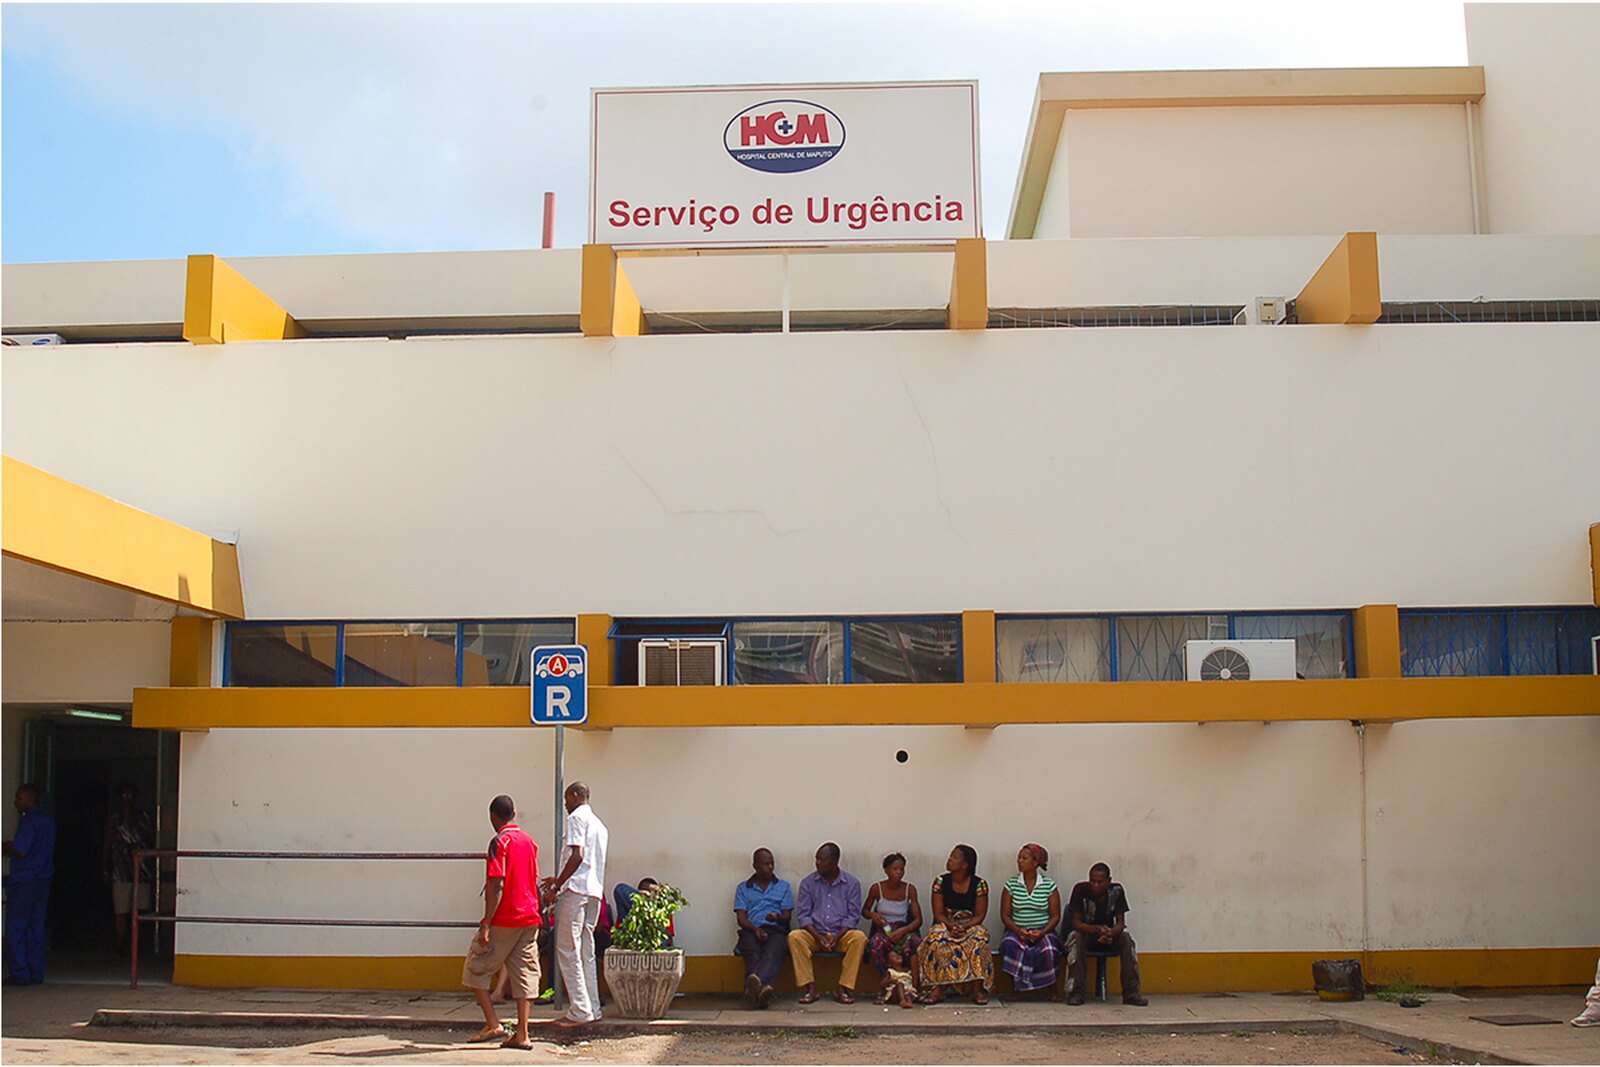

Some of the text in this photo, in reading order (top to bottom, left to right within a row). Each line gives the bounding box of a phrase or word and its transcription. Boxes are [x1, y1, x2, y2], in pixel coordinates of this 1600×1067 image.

[741, 112, 830, 147] HCM
[737, 153, 767, 161] HOSPITAL
[767, 152, 795, 160] CENTRAL
[806, 150, 833, 158] MAPUTO
[609, 195, 963, 233] Serviço de Urgência
[551, 657, 563, 672] A
[546, 685, 571, 717] R
